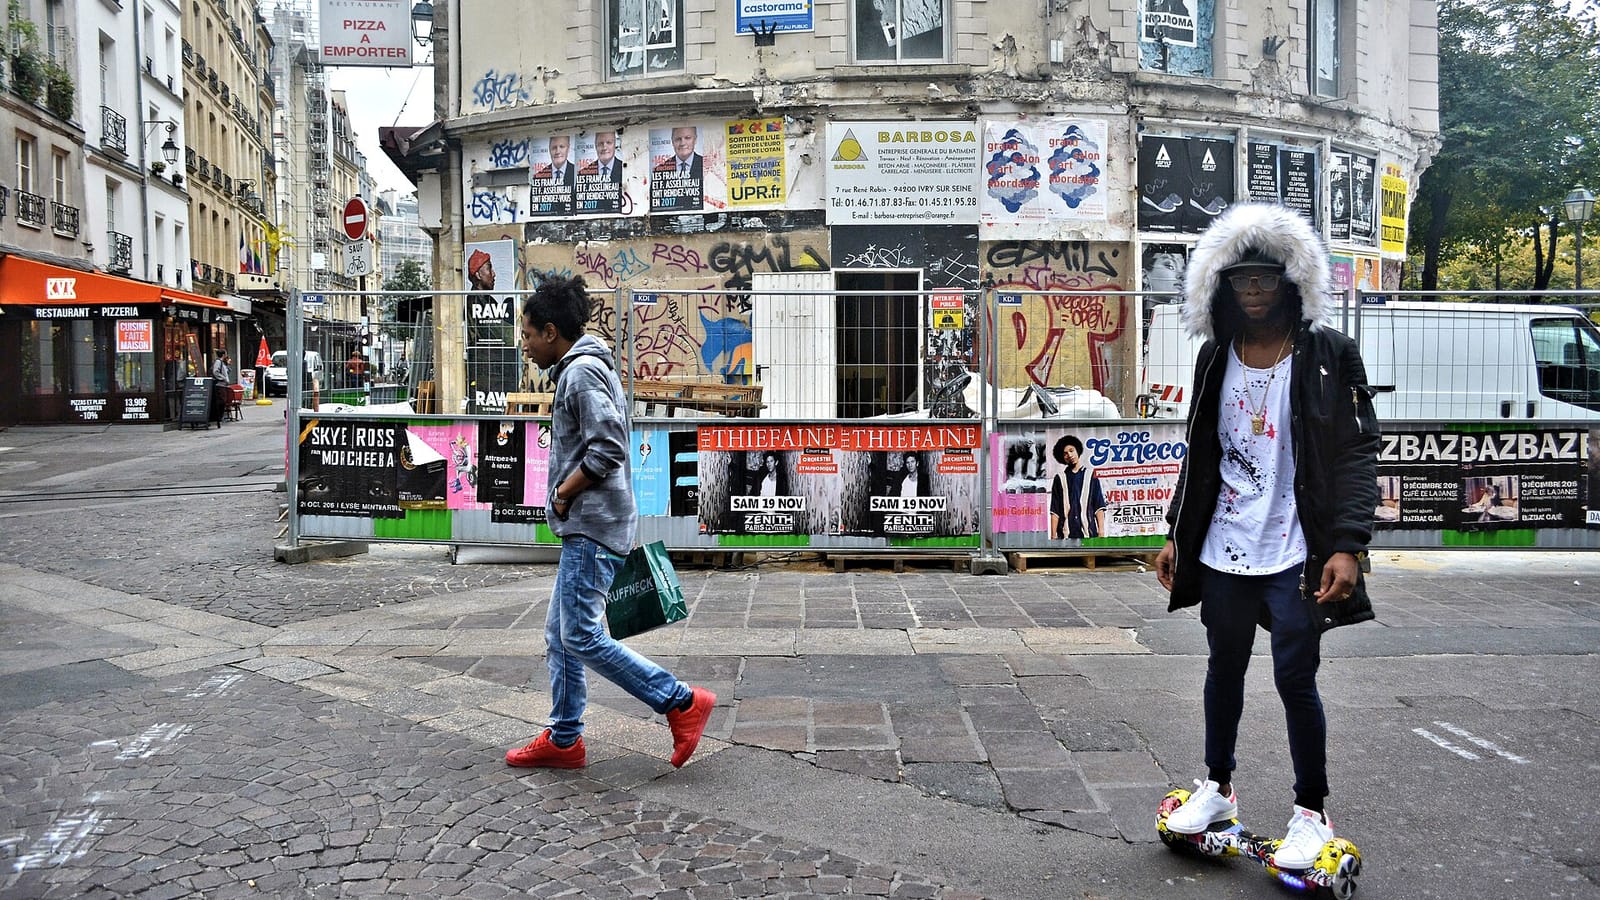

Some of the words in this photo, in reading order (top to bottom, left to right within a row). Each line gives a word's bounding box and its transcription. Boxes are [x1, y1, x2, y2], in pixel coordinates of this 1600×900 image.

[329, 1, 400, 9] RESTAURANT
[744, 3, 802, 13] castorama
[343, 20, 386, 31] PIZZA
[360, 34, 370, 43] A
[324, 46, 407, 57] EMPORTER
[878, 131, 976, 143] BARBOSA
[988, 142, 1018, 152] grand
[1049, 138, 1078, 147] grand
[1012, 154, 1040, 163] salon
[1073, 151, 1100, 160] salon
[577, 175, 585, 183] LES
[653, 172, 661, 180] LES
[731, 171, 749, 179] DANS
[758, 169, 781, 177] MONDE
[589, 183, 619, 191] ASSELINEAU
[652, 181, 658, 189] ET
[665, 179, 700, 188] ASSELINEAU
[587, 191, 619, 199] RENDEZ-VOUS
[664, 187, 700, 197] RENDEZ-VOUS
[731, 185, 781, 200] UPR.fr
[540, 203, 552, 211] 2017
[653, 199, 660, 207] EN
[661, 198, 676, 206] 2017
[919, 198, 977, 206] 01.45.21.95.28
[349, 244, 364, 254] SAUF
[36, 308, 89, 318] RESTAURANT
[102, 307, 139, 317] PIZZERIA
[472, 303, 509, 318] RAW.
[120, 322, 148, 331] CUISINE
[124, 331, 144, 340] FAITE
[120, 341, 149, 350] MAISON
[312, 427, 347, 446] SKYE
[357, 427, 395, 447] ROSS
[1117, 431, 1150, 444] DOC
[322, 450, 394, 467] MORCHEEBA
[1106, 490, 1128, 501] VEN
[1132, 490, 1145, 500] 18
[1147, 489, 1171, 500] NOV
[733, 498, 759, 509] SAM
[762, 498, 775, 508] 19
[778, 498, 803, 508] NOV
[872, 499, 899, 509] SAM
[902, 499, 916, 509] 19
[919, 499, 945, 509] NOV
[1113, 506, 1163, 516] ZENITH
[744, 515, 793, 524] ZENITH
[883, 516, 934, 525] ZENITH
[606, 576, 654, 604] RUFFNECK
